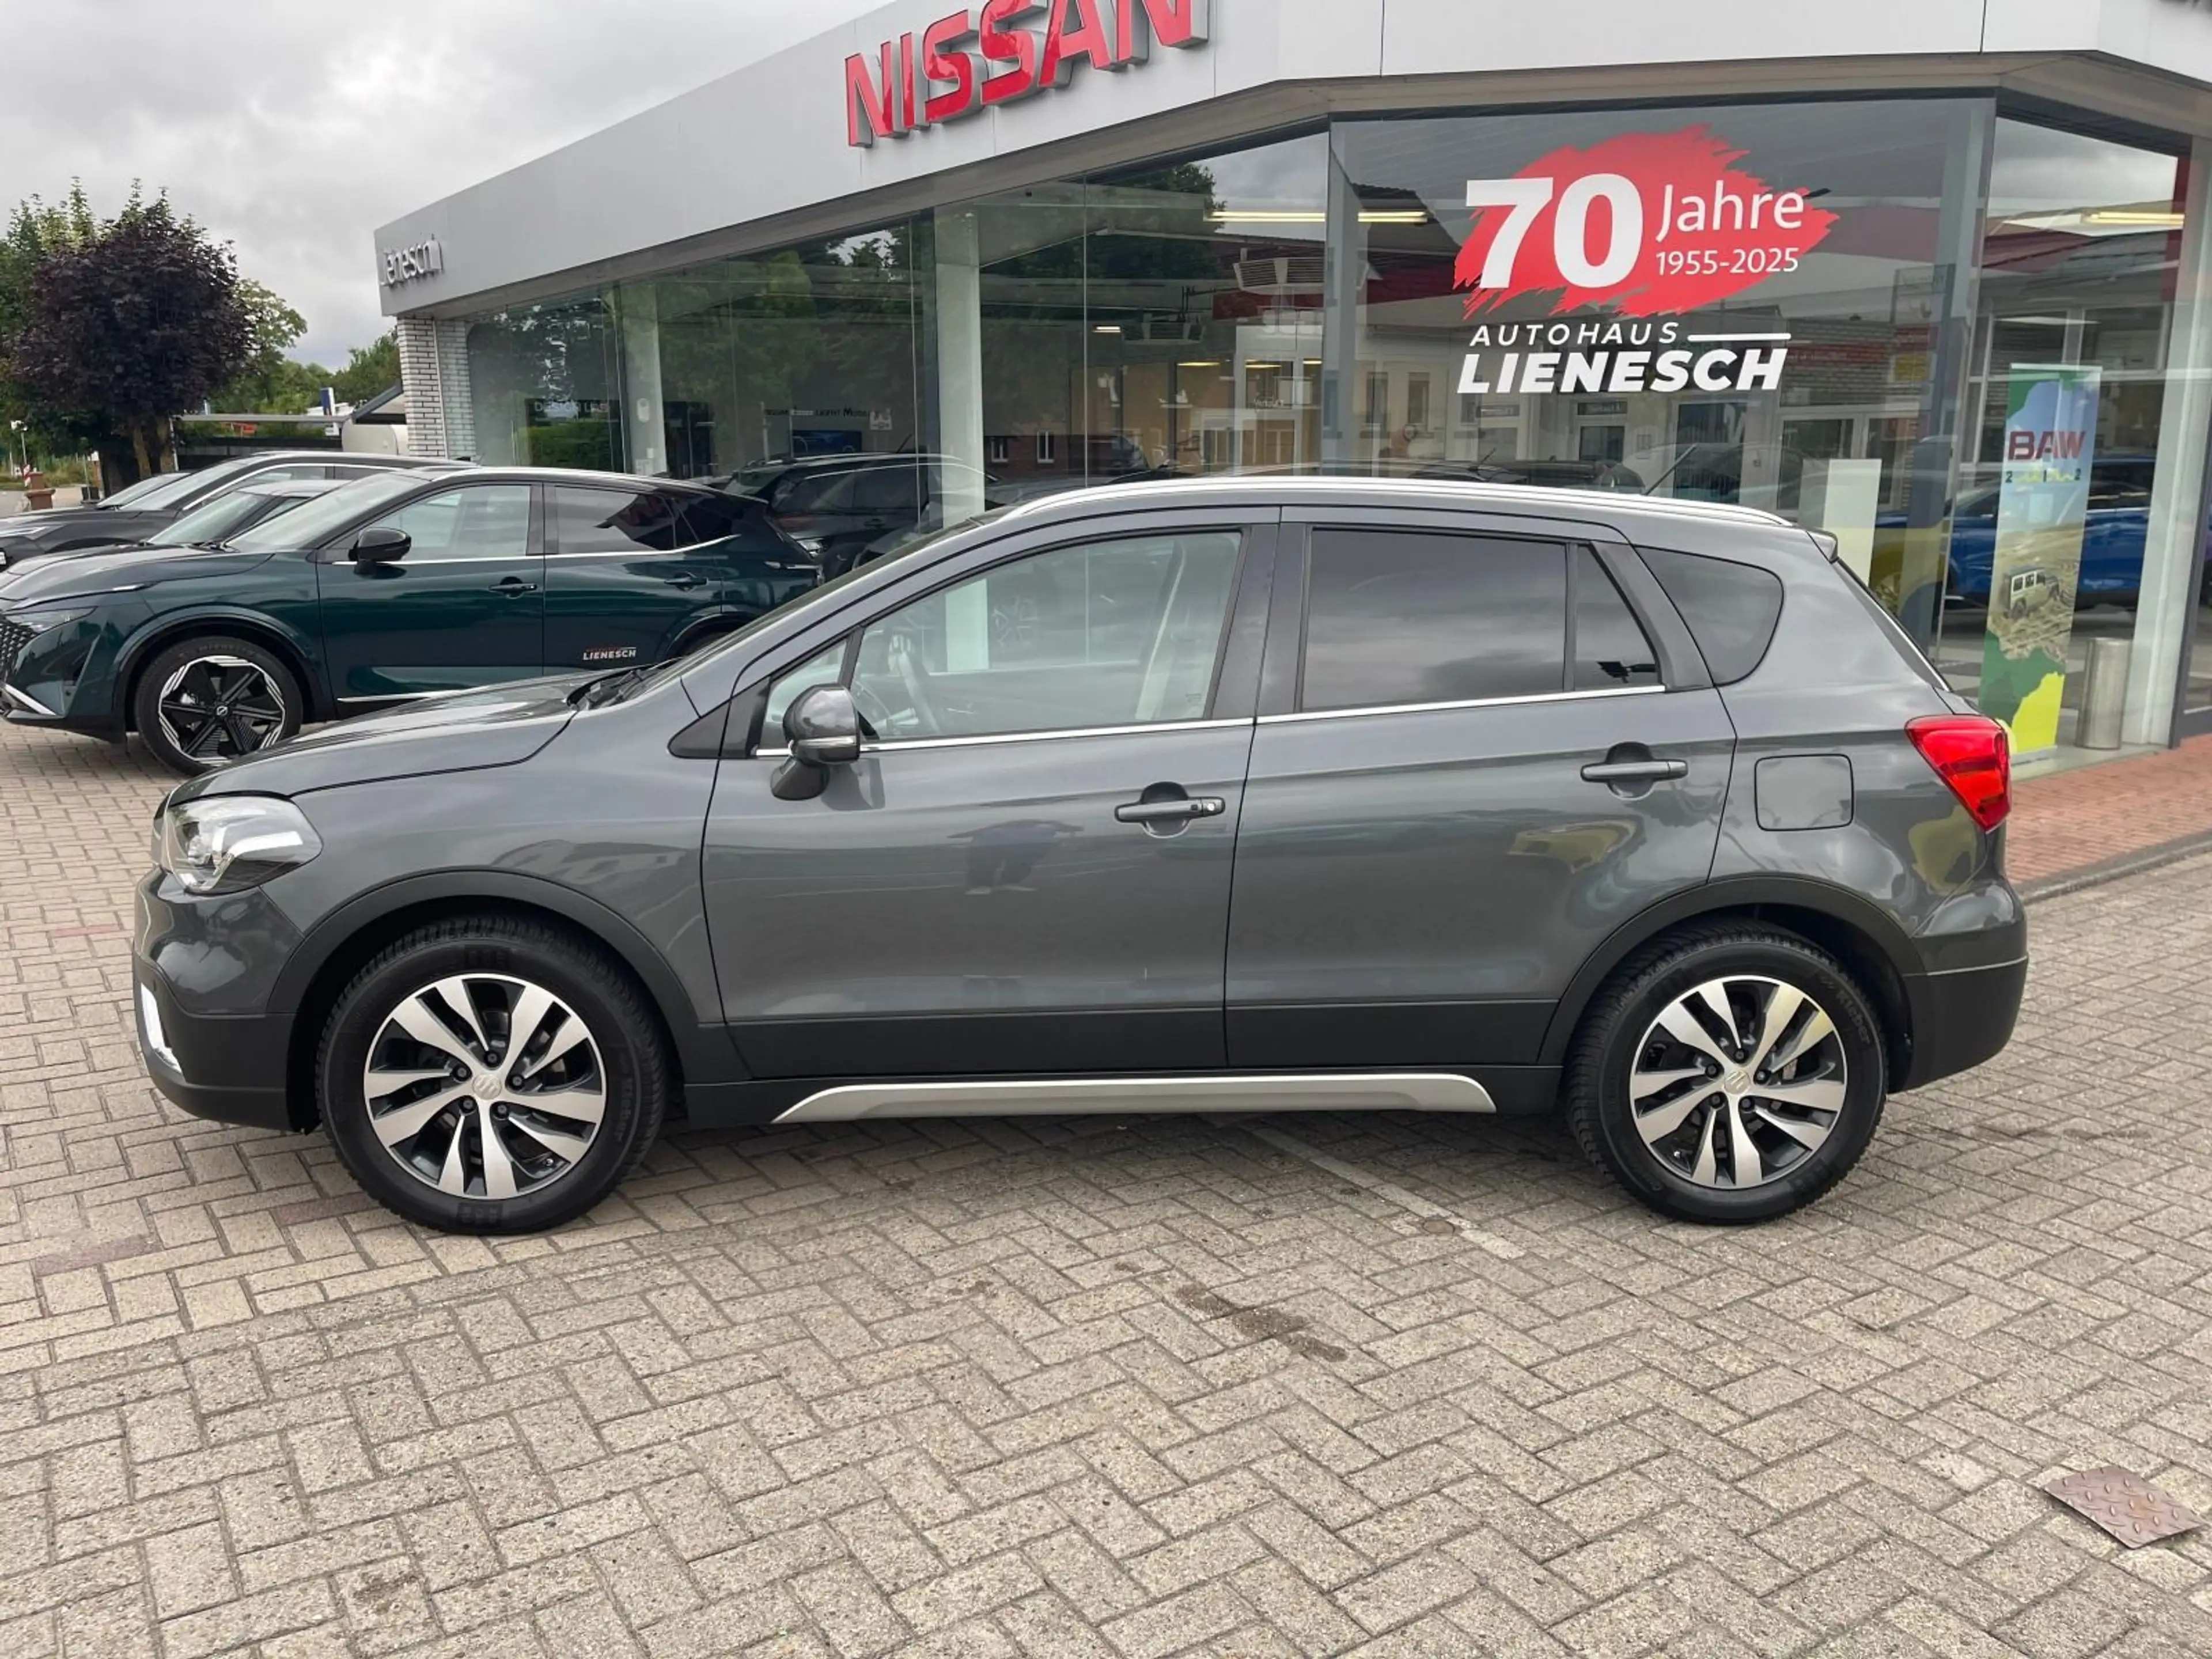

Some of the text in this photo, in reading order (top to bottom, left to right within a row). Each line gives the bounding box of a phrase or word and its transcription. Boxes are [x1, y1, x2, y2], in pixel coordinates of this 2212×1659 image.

[845, 0, 1208, 147] NISSAN
[1467, 173, 1804, 289] 70 Jahre
[1656, 248, 1799, 275] 1955-2025
[1469, 322, 1679, 346] AUTOHAUS
[1457, 348, 1788, 393] LIENESCH
[2008, 431, 2086, 460] BAW
[583, 650, 636, 660] LIENESCH
